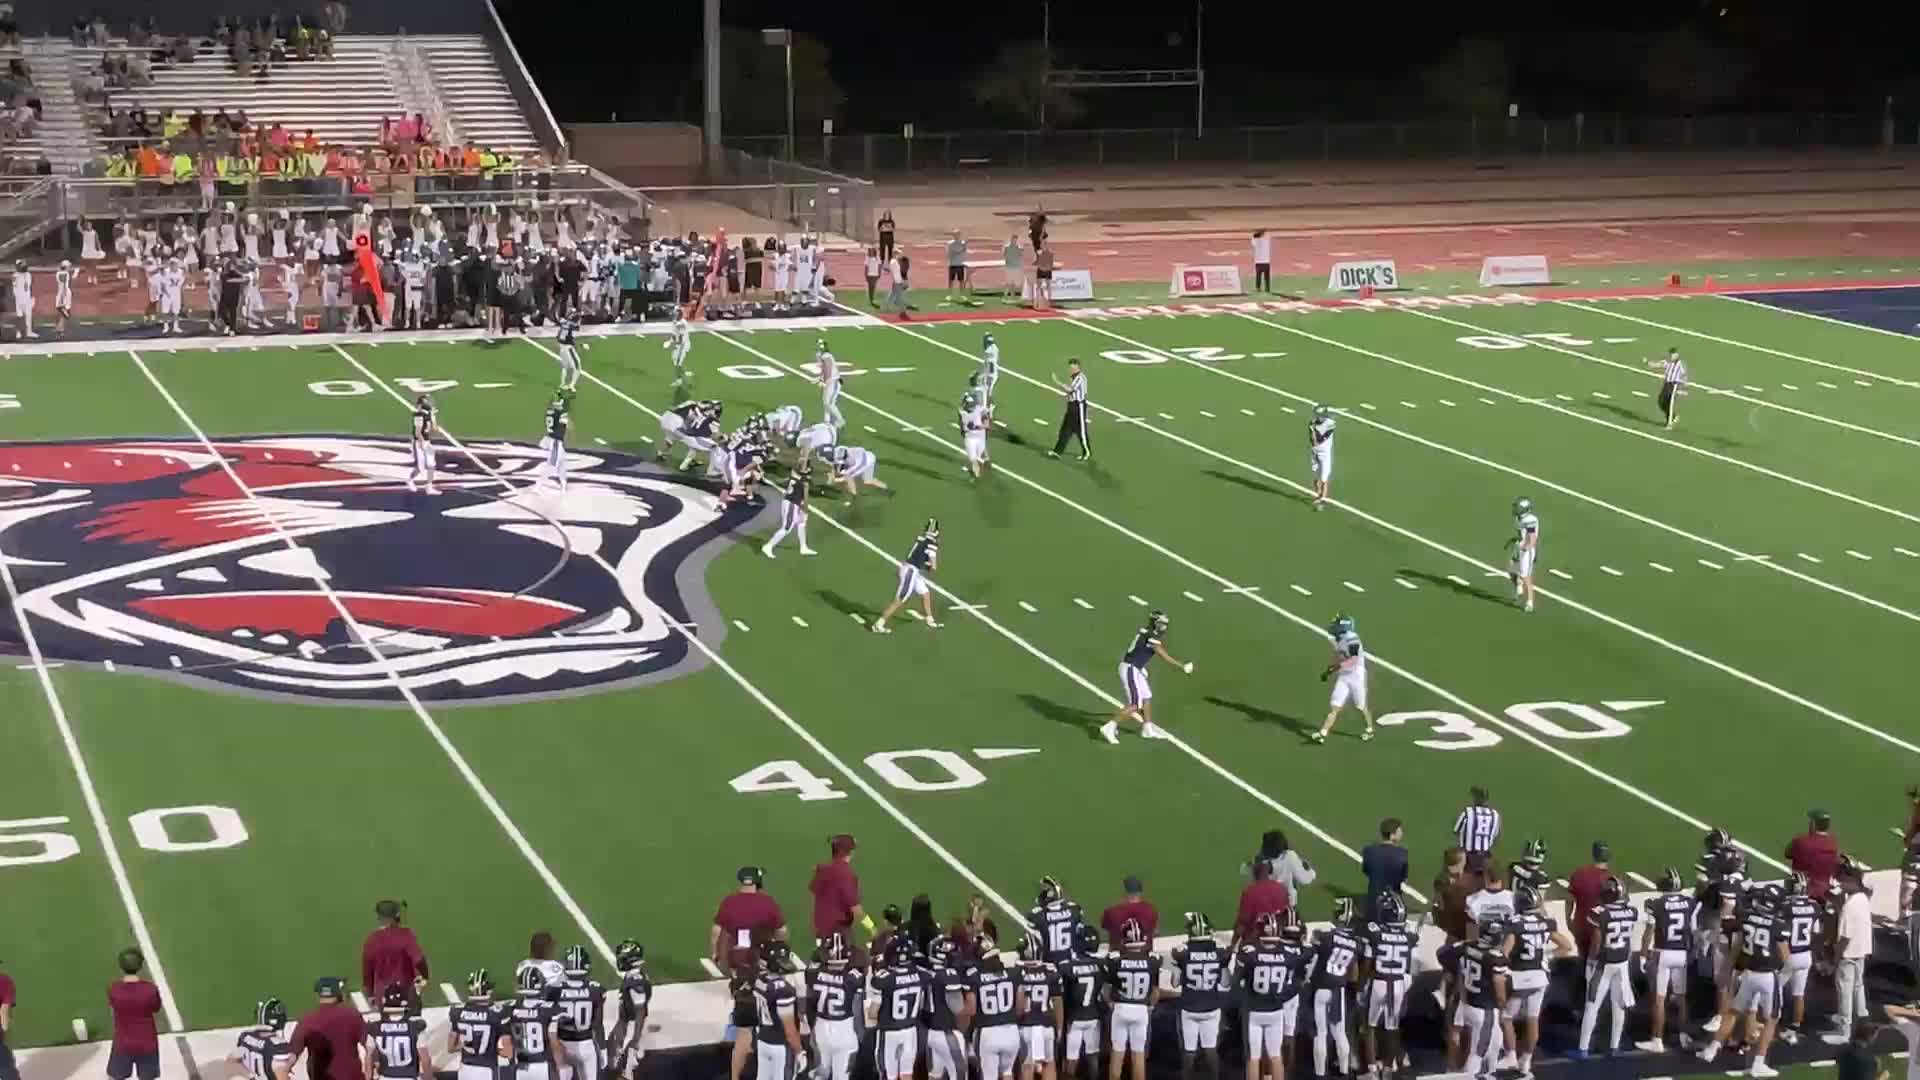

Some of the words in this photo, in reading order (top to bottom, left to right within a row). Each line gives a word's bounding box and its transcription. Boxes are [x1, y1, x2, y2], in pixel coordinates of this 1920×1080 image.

[1340, 265, 1394, 288] DICK'S
[1099, 347, 1248, 364] 20
[307, 378, 459, 396] 40
[1376, 701, 1633, 751] 30
[727, 748, 988, 801] 40
[0, 805, 249, 867] 50
[1048, 921, 1072, 951] 16
[1667, 912, 1685, 942] 2
[1376, 944, 1409, 974] 25
[1078, 976, 1095, 1007] 7
[1117, 972, 1150, 1000] 38
[1253, 966, 1288, 993] 89
[813, 984, 846, 1016] 72
[892, 986, 922, 1019] 67
[980, 981, 1014, 1015] 60
[376, 1035, 412, 1067] 40
[457, 1022, 491, 1055] 27
